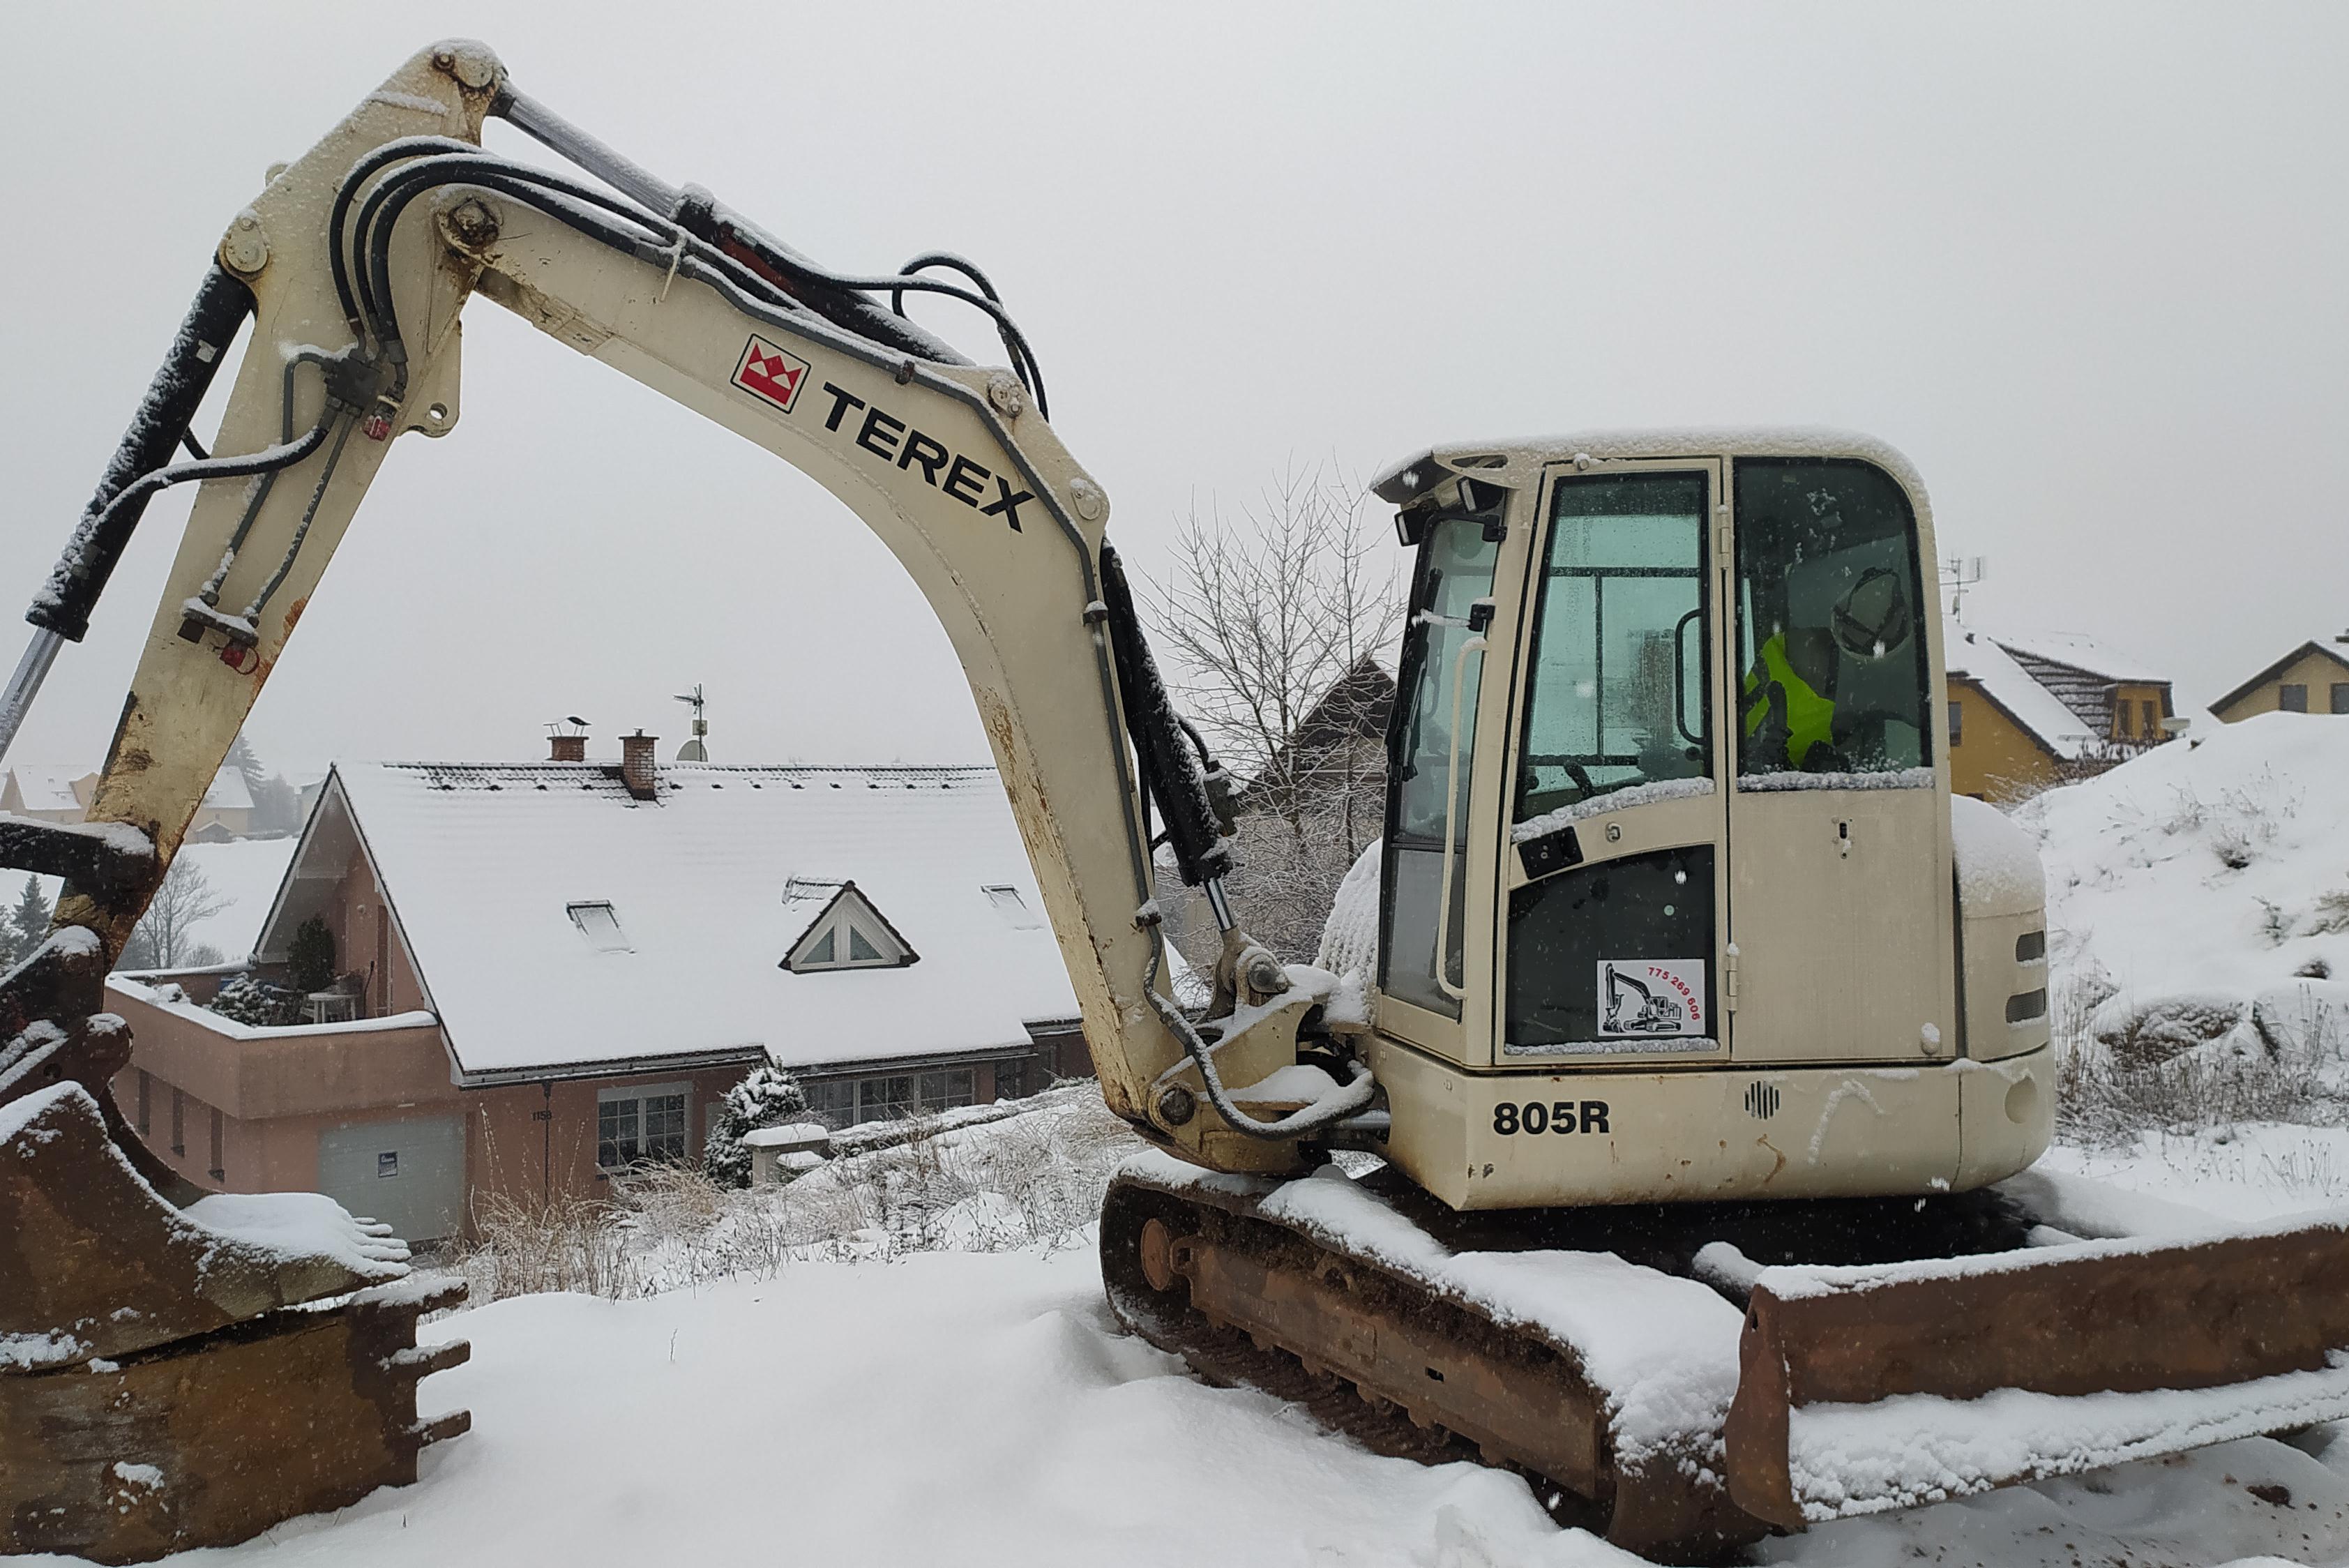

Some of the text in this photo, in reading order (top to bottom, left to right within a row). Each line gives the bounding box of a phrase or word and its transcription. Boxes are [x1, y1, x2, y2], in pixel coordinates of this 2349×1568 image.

[823, 381, 1035, 534] TEREX
[1647, 966, 1700, 1020] 775 269 606
[1493, 1101, 1610, 1136] 805R
